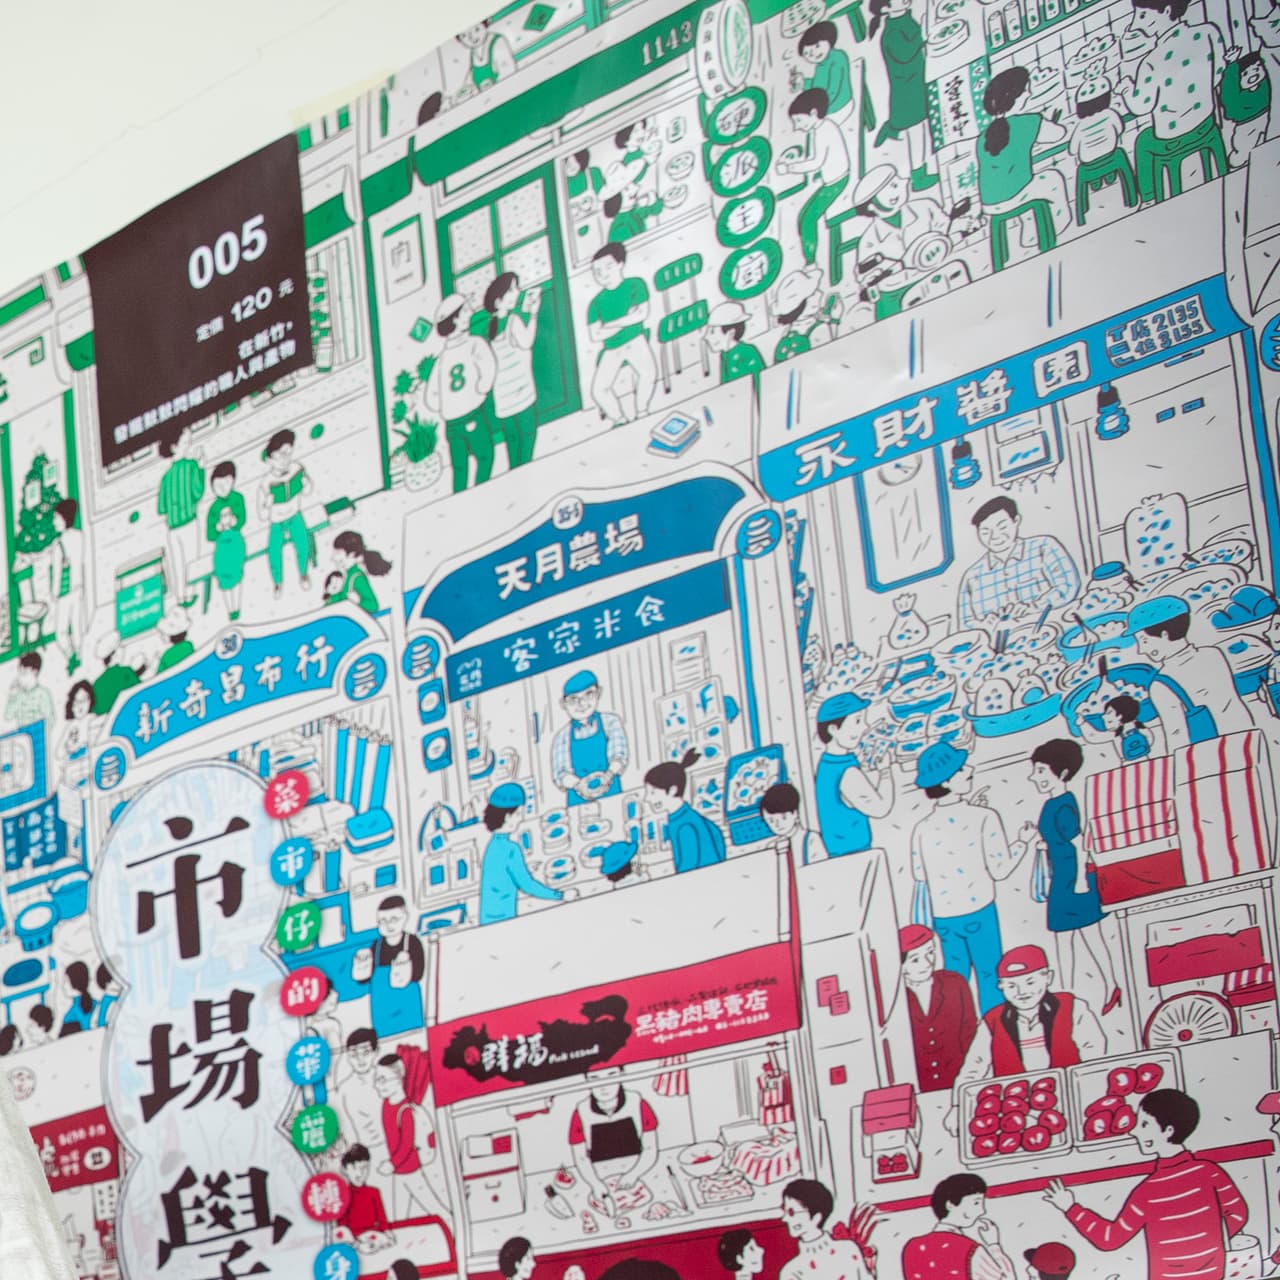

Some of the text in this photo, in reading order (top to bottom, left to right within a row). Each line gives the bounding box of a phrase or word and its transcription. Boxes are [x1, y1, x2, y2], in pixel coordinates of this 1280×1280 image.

[642, 20, 693, 66] 1143
[188, 214, 268, 289] 005
[231, 286, 273, 322] 120
[449, 364, 467, 393] 8
[495, 514, 644, 600] 天月農場
[503, 595, 665, 673] 客家米食
[134, 635, 334, 743] 新奇昌布行
